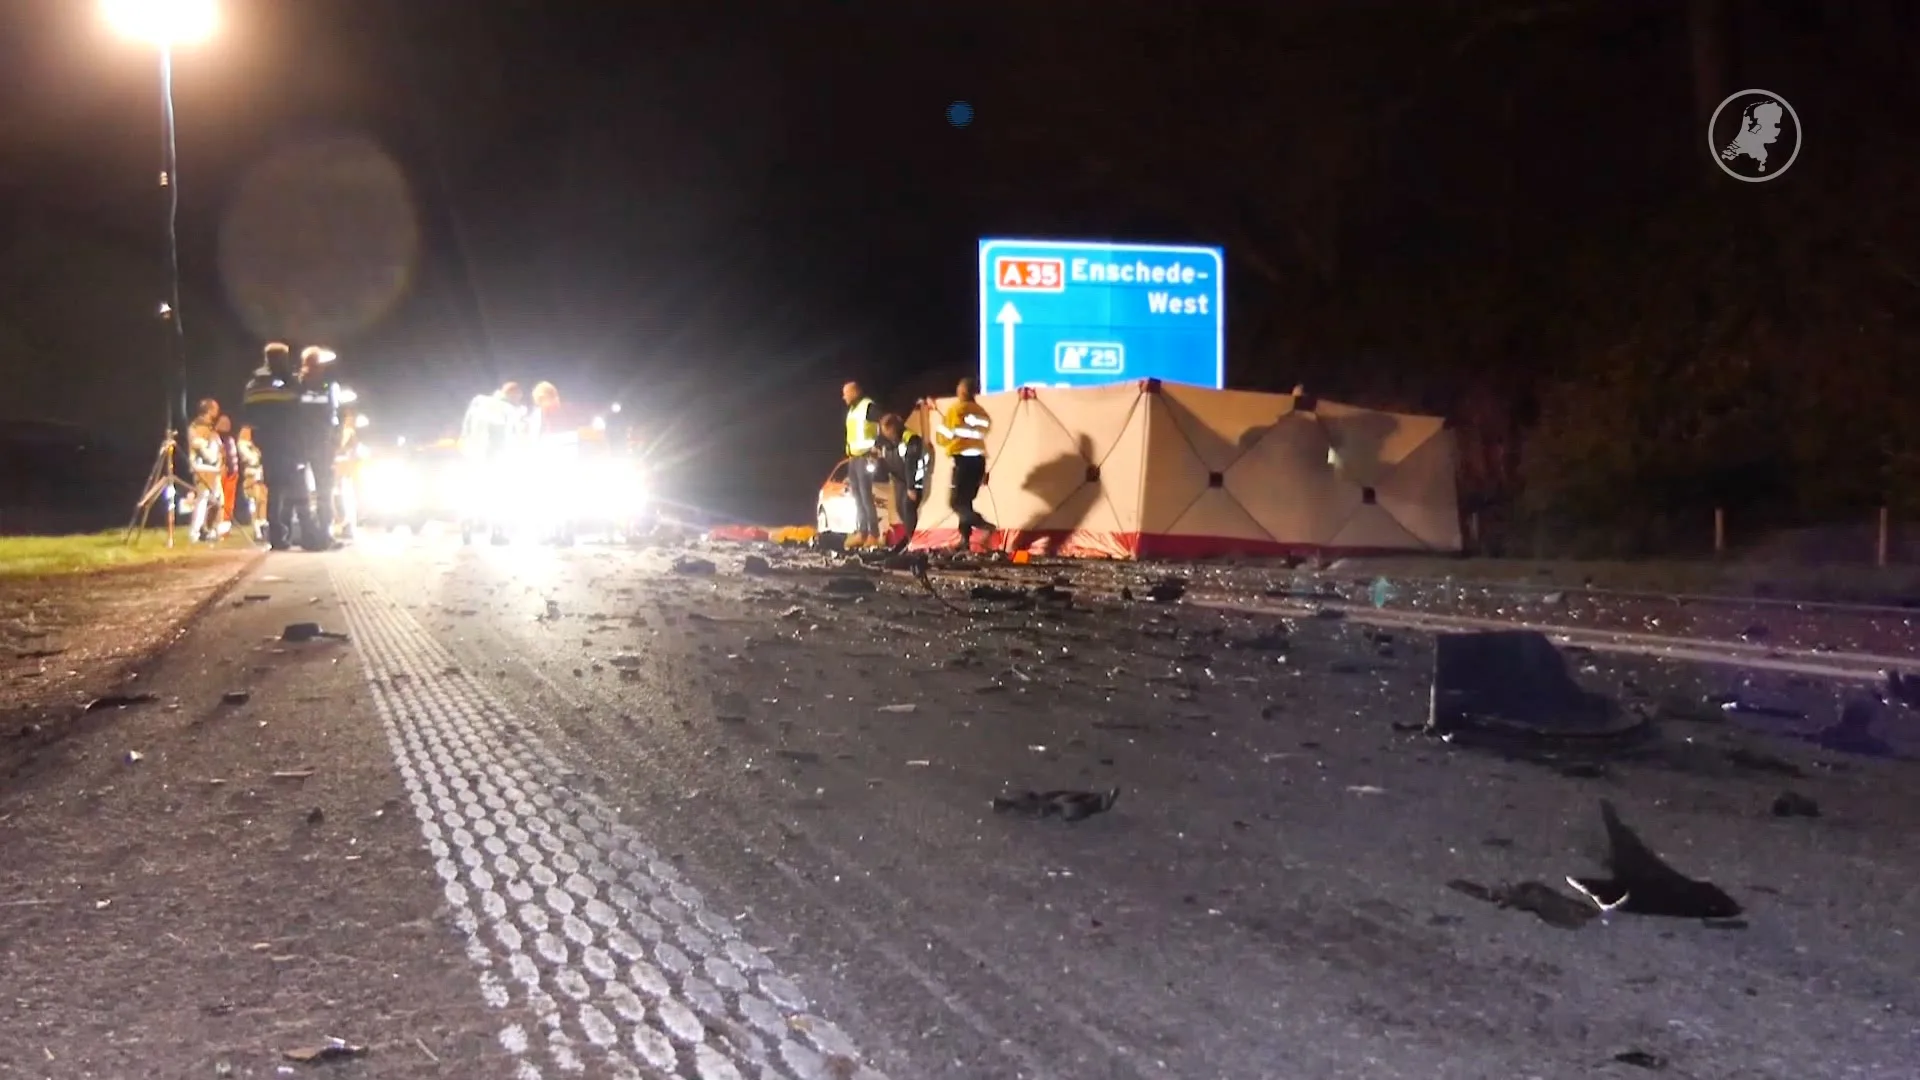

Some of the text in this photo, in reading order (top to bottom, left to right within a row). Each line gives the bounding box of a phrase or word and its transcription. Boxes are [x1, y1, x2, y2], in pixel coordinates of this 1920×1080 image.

[1002, 258, 1209, 286] A35 Enschede-
[1147, 291, 1209, 315] West
[1090, 349, 1118, 367] 25
